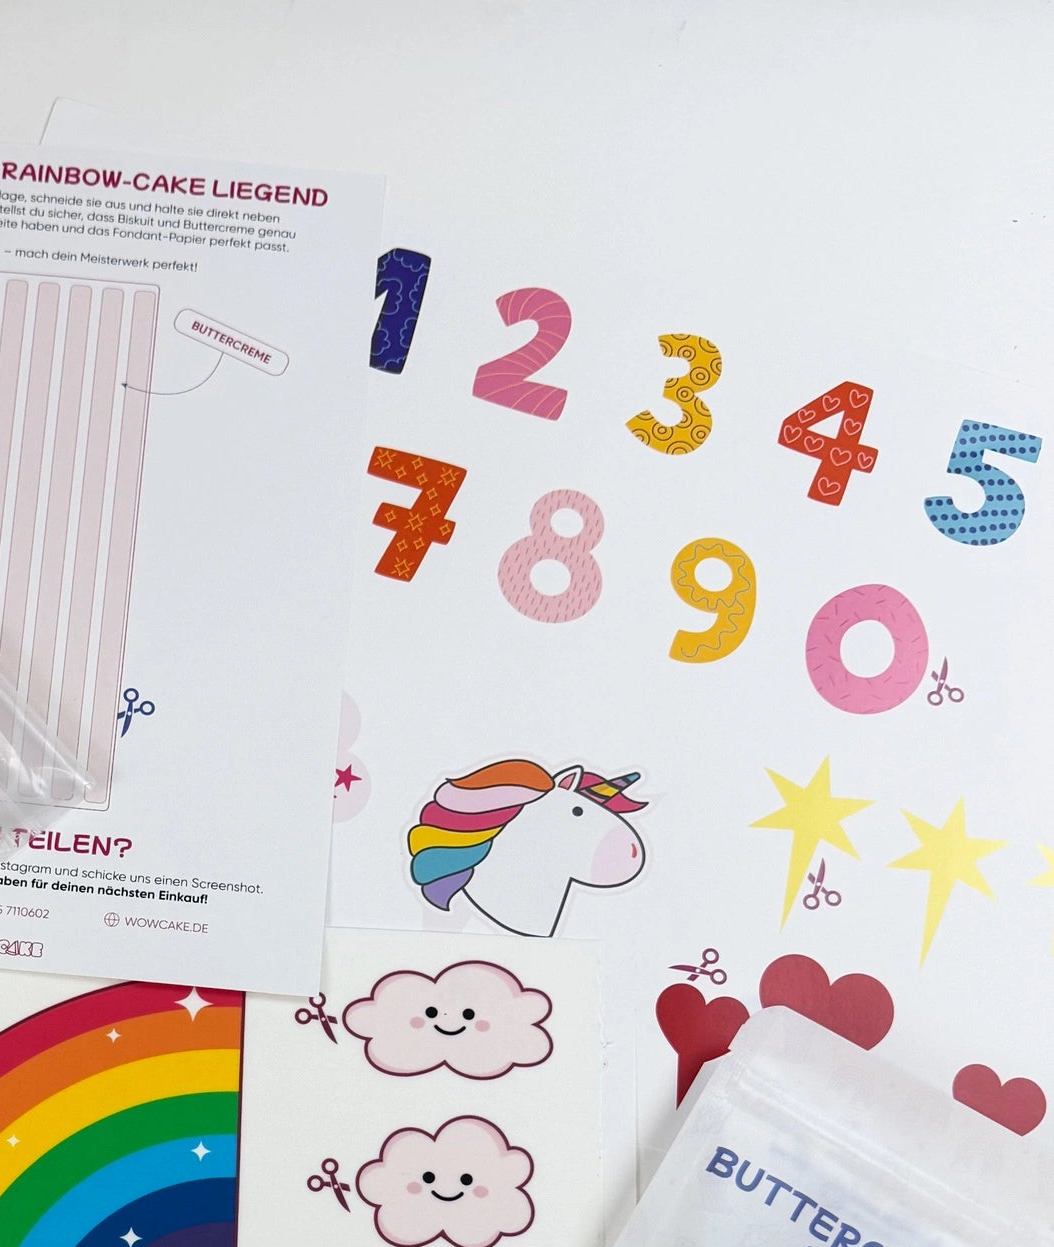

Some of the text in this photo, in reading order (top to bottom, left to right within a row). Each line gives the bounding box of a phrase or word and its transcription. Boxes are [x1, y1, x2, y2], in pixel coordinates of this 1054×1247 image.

[1, 161, 206, 196] RAINBOW-CAKE
[211, 179, 329, 207] LIEGEND
[29, 206, 45, 218] du
[47, 208, 84, 222] sicher,
[87, 212, 115, 223] dass
[117, 214, 155, 227] Biskuit
[157, 217, 181, 229] und
[183, 219, 255, 236] Buttercreme
[257, 226, 297, 240] genau
[30, 192, 83, 207] schneide
[86, 198, 102, 208] sie
[105, 200, 126, 211] aus
[128, 202, 152, 213] und
[154, 203, 185, 216] halte
[187, 206, 204, 217] sie
[206, 208, 239, 221] direkt
[242, 212, 281, 224] neben
[20, 219, 59, 233] haben
[62, 223, 85, 235] und
[87, 225, 110, 238] das
[112, 227, 206, 247] Fondant-Papier
[209, 235, 252, 249] perfekt
[254, 241, 290, 254] passt.
[15, 247, 49, 260] mach
[51, 250, 78, 262] dein
[80, 252, 150, 269] Meisterwerk
[152, 258, 199, 273] perfekt!
[190, 320, 273, 366] BUTTERCREME
[368, 247, 1044, 547] 1 2 3 4 5
[365, 444, 931, 716] 7 8 9 0
[10, 826, 133, 859] TEILEN?
[30, 877, 49, 889] für
[51, 880, 94, 894] deinen
[97, 885, 156, 900] nächsten
[158, 889, 209, 905] Einkauf!
[54, 865, 78, 878] und
[81, 868, 127, 882] schicke
[129, 873, 151, 884] uns
[154, 874, 189, 888] einen
[191, 877, 264, 895] Screenshot.
[6, 904, 50, 919] 7110602
[124, 916, 209, 934] WOWCAKE.DE
